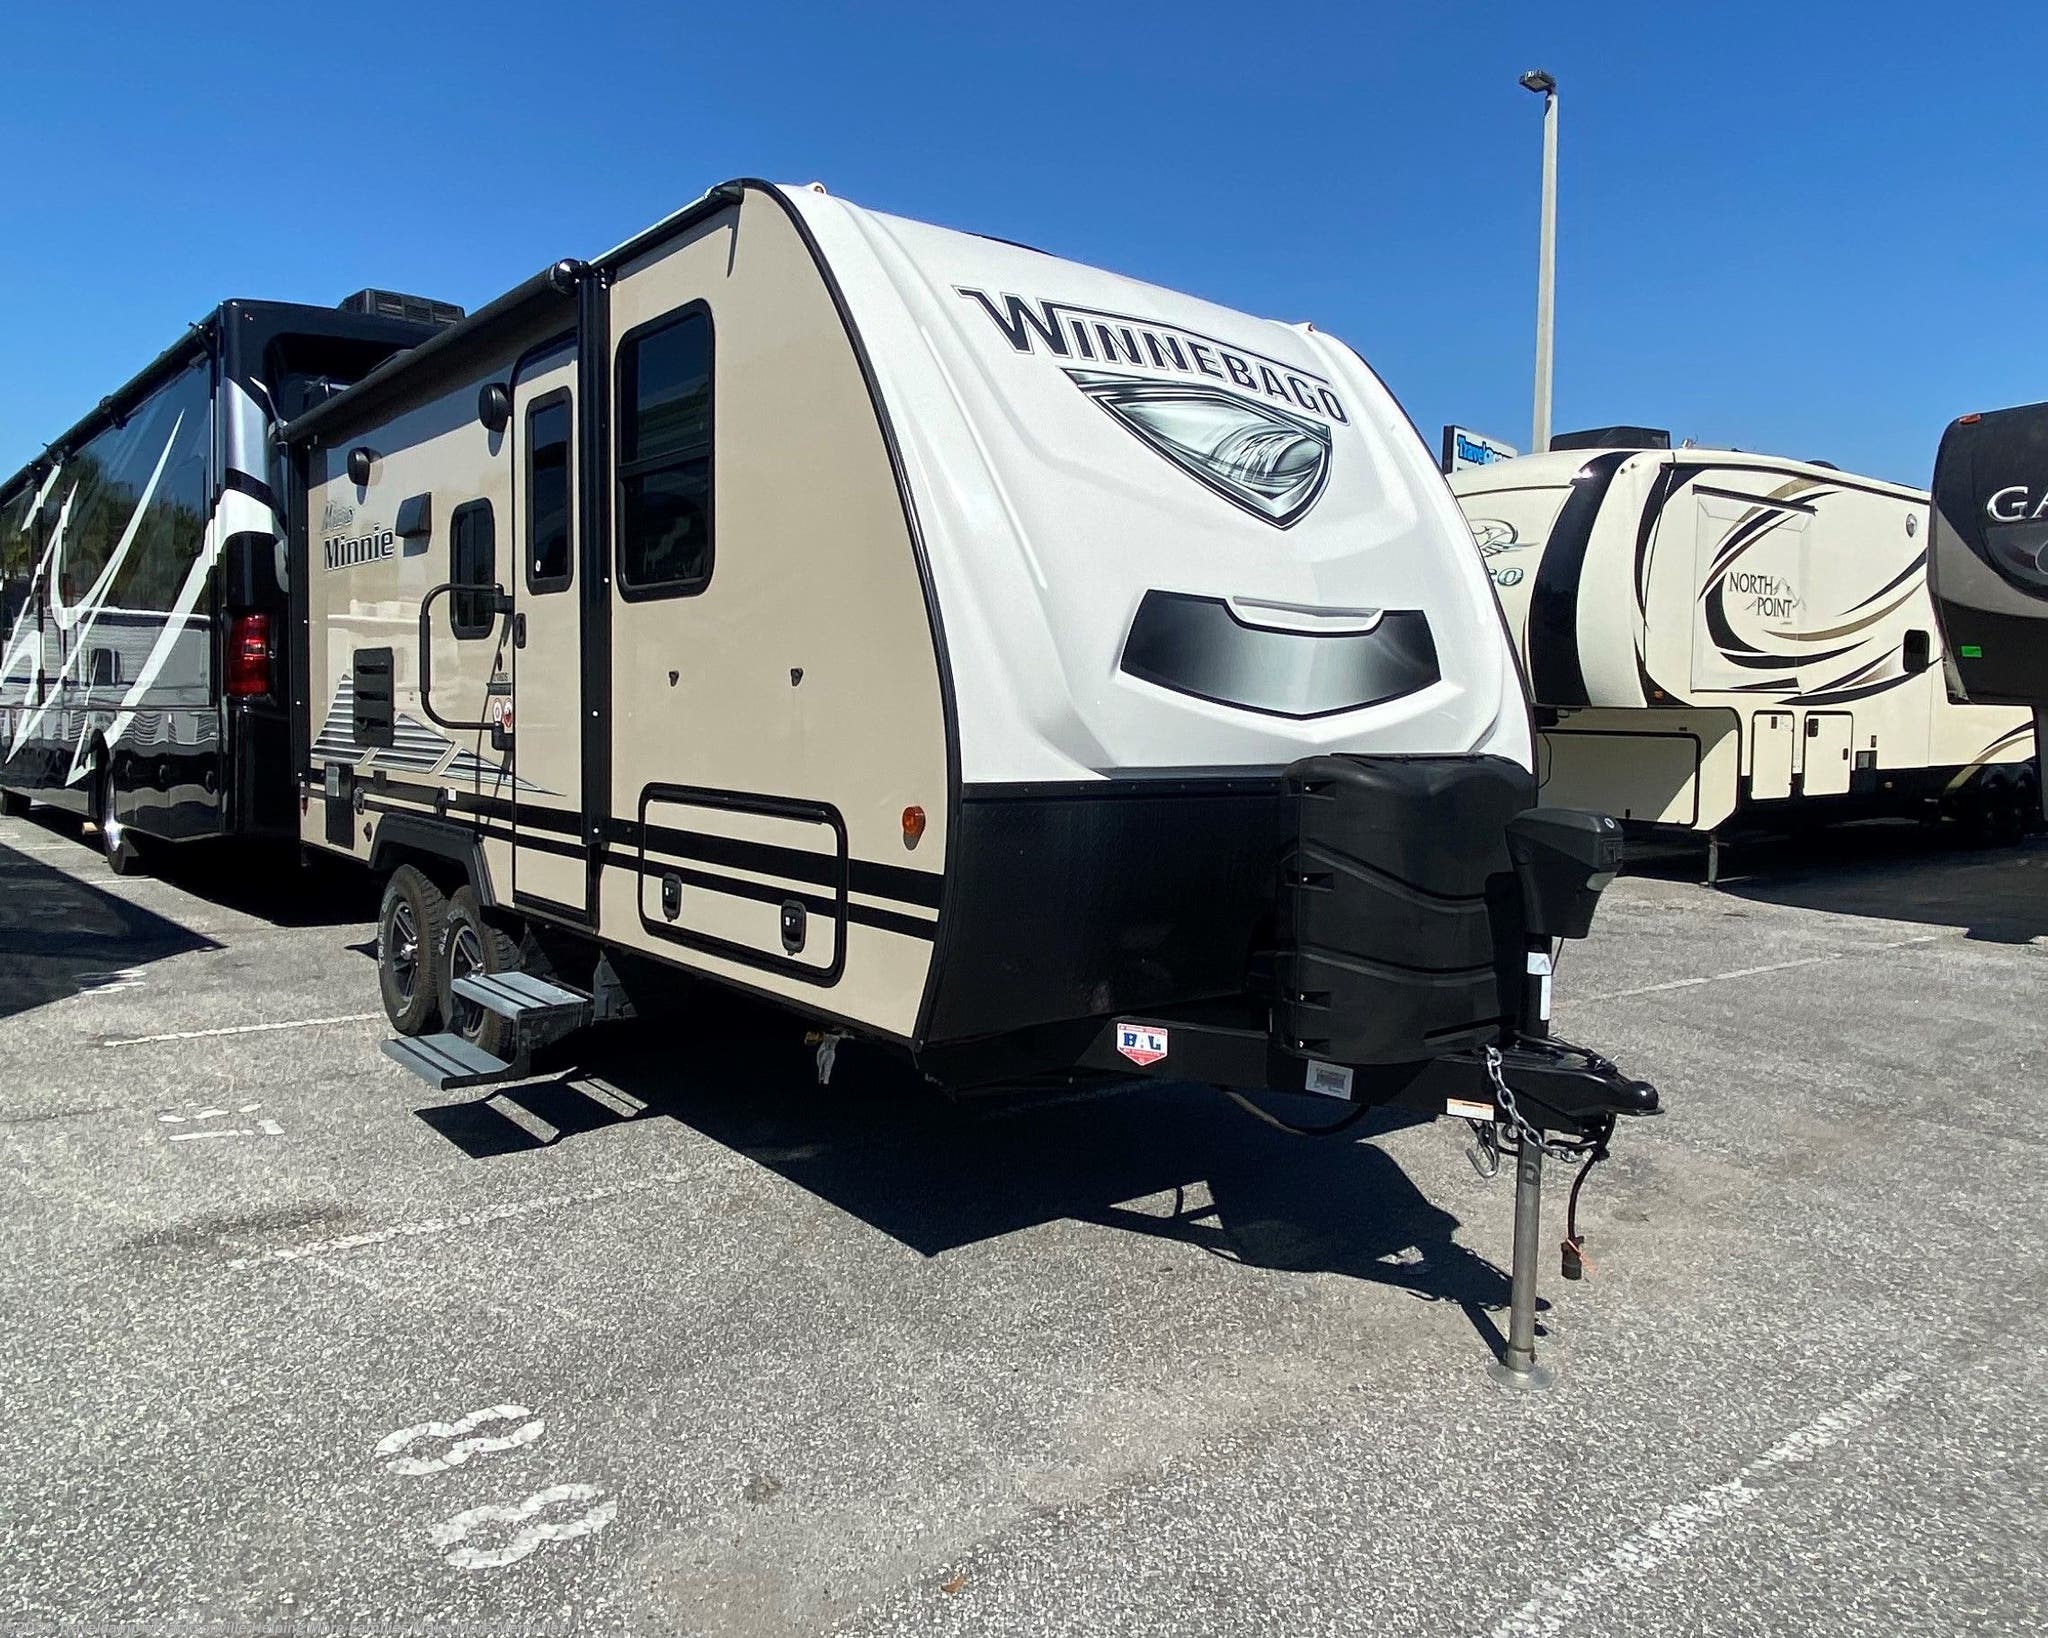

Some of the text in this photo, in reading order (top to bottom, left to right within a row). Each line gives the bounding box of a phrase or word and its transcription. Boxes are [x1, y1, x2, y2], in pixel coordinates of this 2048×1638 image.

[951, 285, 1351, 427] WINNEBAGO
[324, 523, 394, 571] Minnie
[1729, 571, 1774, 596] NORTH
[1757, 596, 1793, 618] POINT
